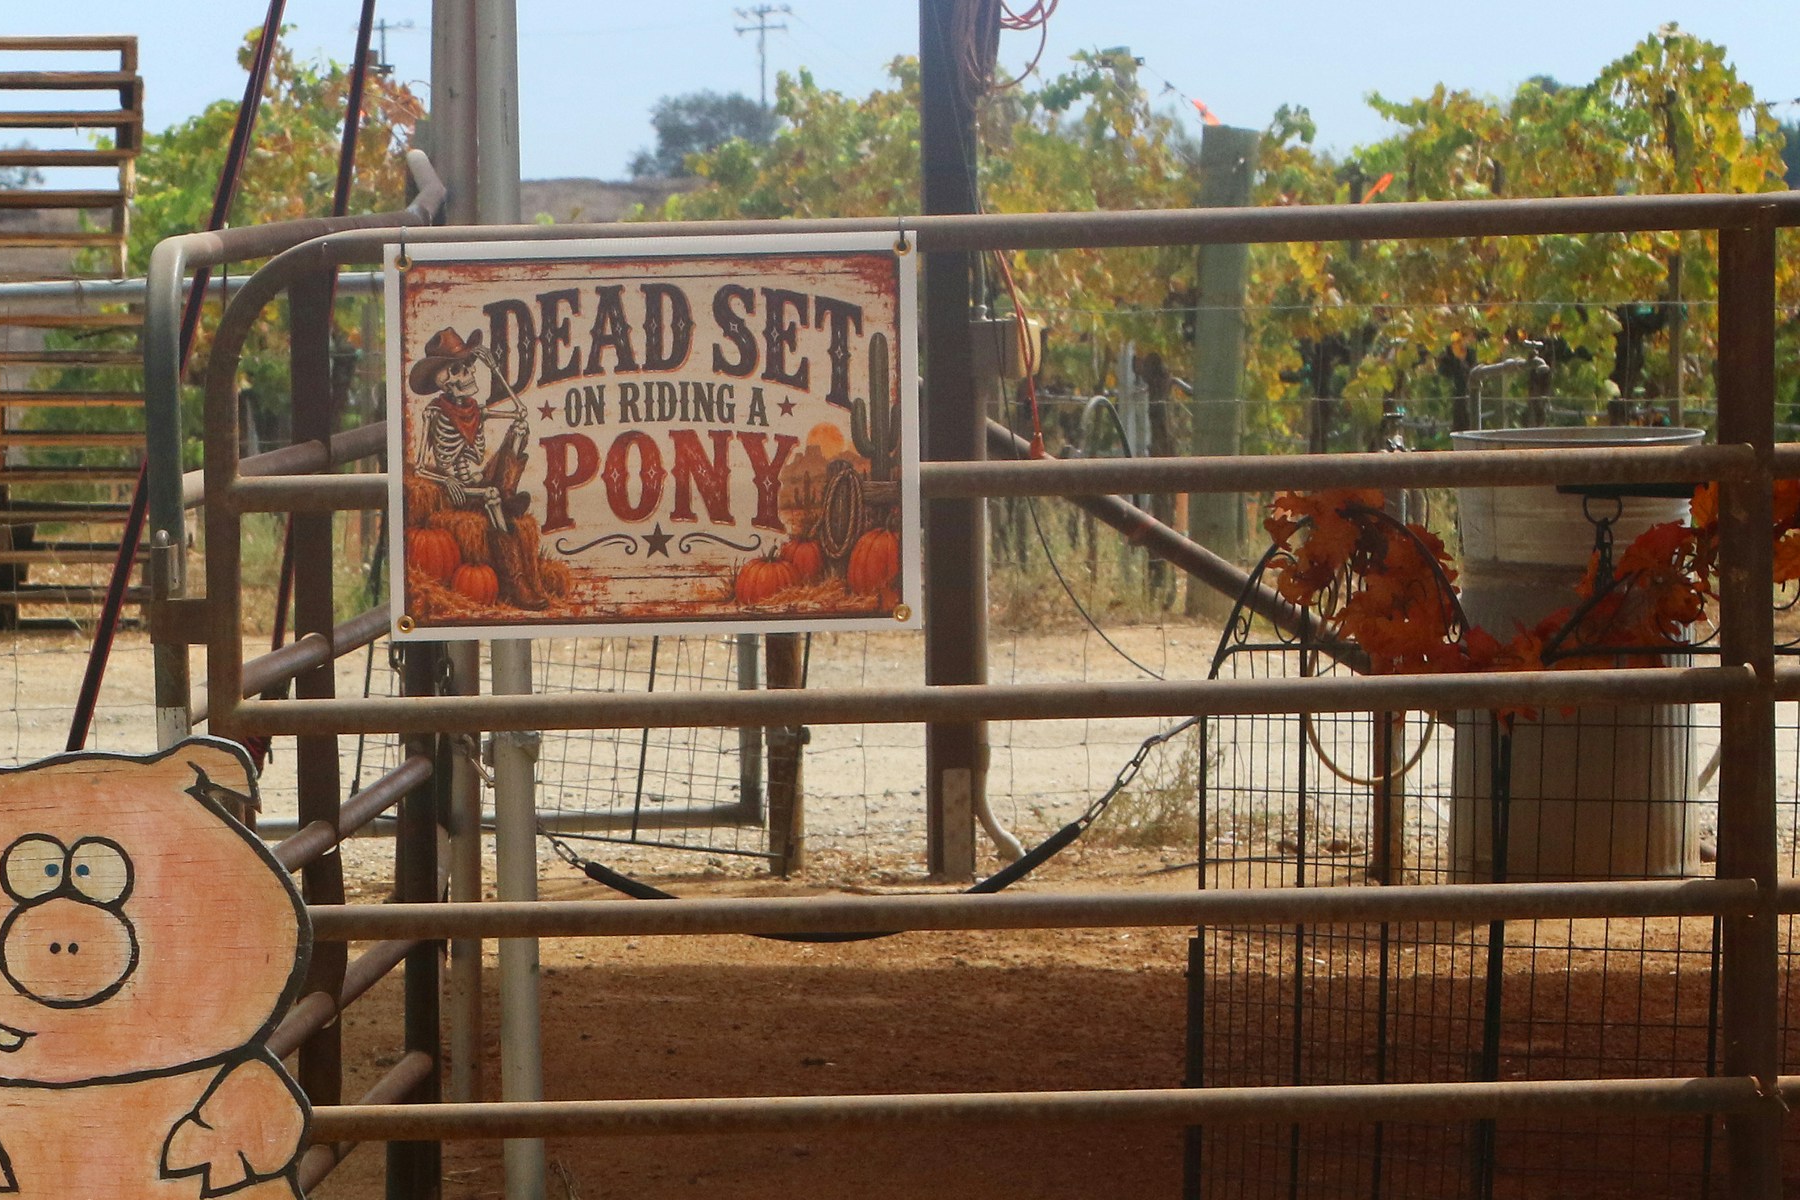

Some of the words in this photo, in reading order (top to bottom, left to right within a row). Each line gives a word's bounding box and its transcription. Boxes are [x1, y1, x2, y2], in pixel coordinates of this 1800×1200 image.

[482, 283, 696, 405] DEAD
[712, 284, 863, 409] SET
[564, 384, 606, 428] ON
[618, 381, 735, 424] RIDING
[746, 387, 770, 427] A
[539, 429, 799, 534] PONY
